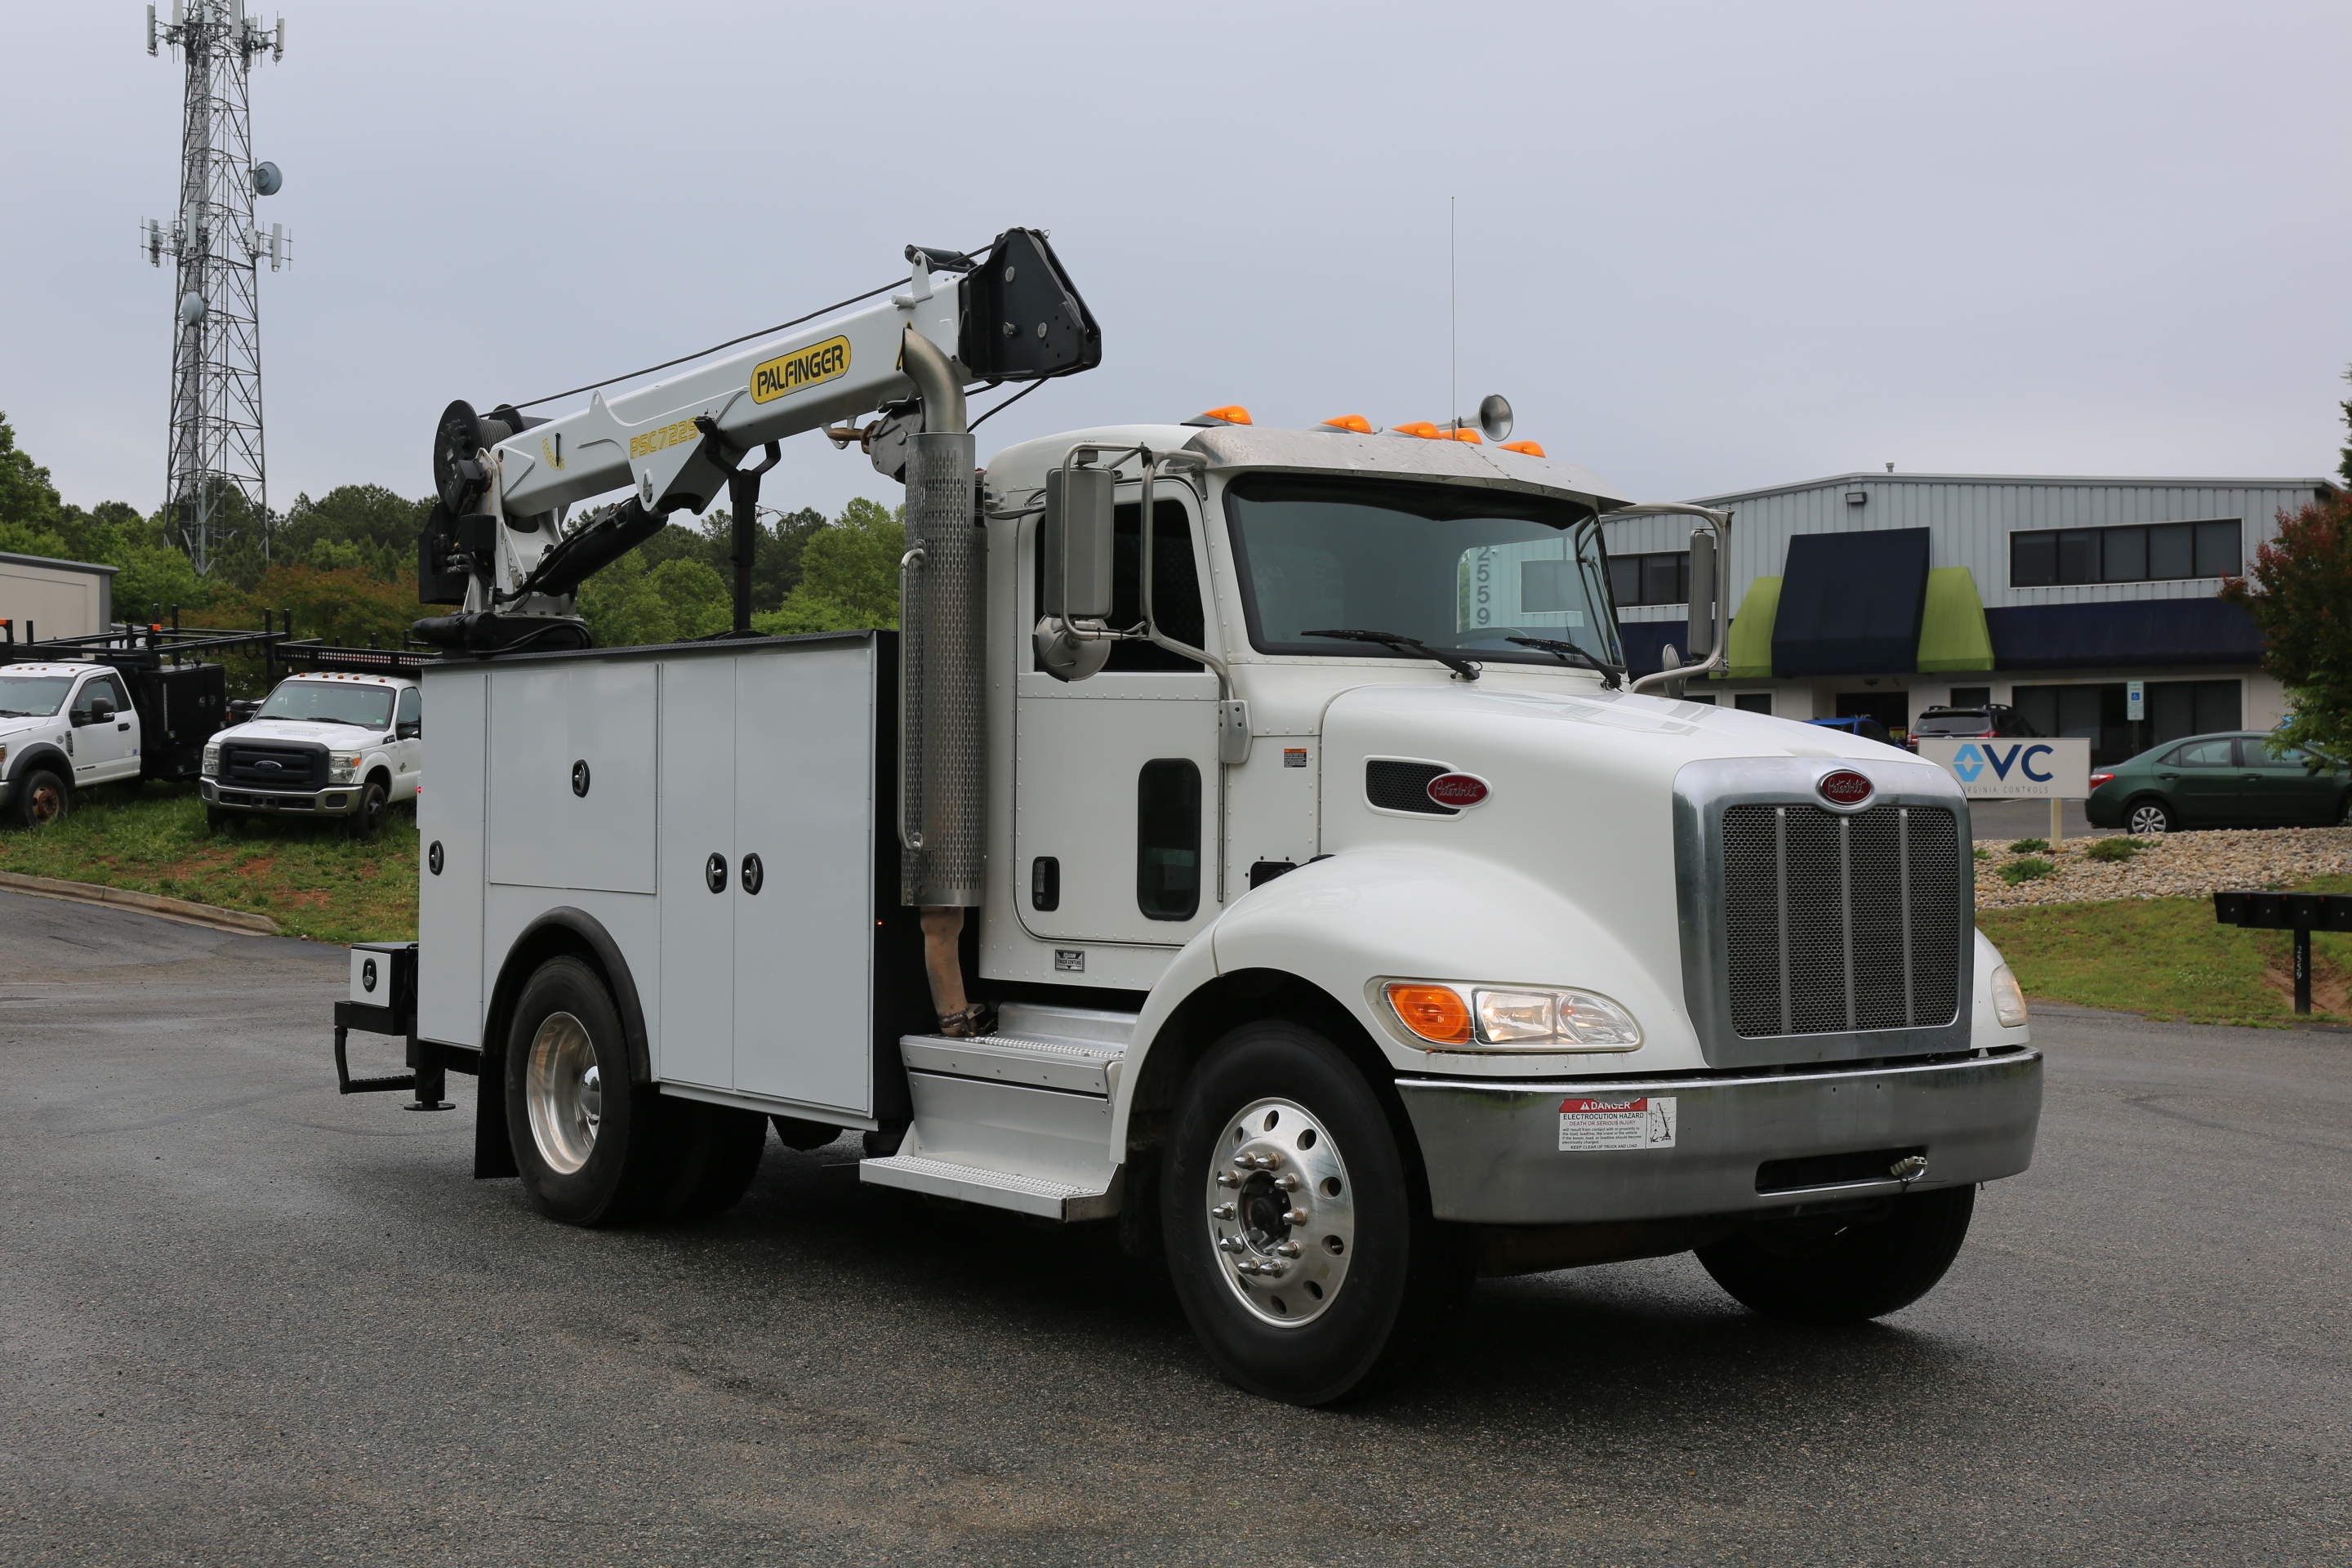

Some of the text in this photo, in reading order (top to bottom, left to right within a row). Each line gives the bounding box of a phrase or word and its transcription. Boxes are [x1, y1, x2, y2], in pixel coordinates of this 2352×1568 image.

[756, 344, 844, 397] PALFINGER
[1434, 779, 1482, 797] Peterbilt
[1828, 777, 1867, 795] Peterbilt
[1963, 786, 2049, 794] IRGINIA CONTROLS
[1591, 1101, 1631, 1110] DANGER
